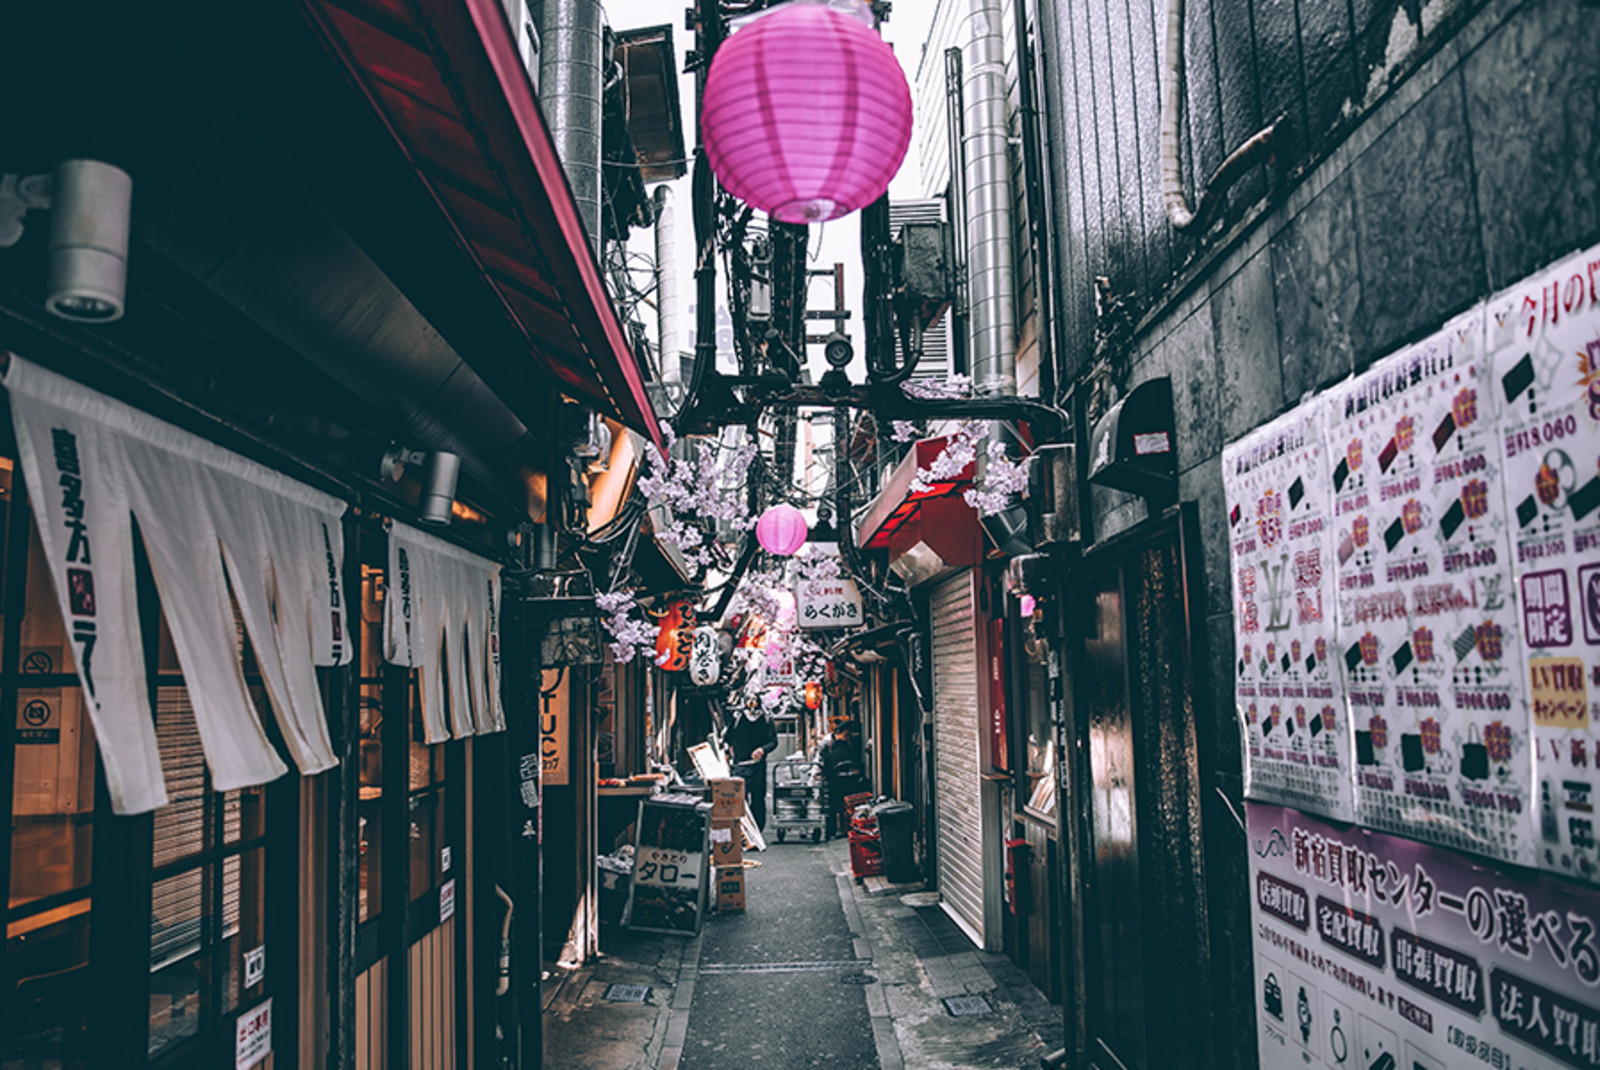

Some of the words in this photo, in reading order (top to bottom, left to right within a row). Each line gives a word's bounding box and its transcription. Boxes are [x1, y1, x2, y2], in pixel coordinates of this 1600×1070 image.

[804, 602, 858, 620] らくがき
[638, 861, 697, 883] タロー
[1292, 828, 1600, 987] 新宿買取センターの選べる
[1319, 905, 1380, 958] 宅配買取
[1396, 938, 1478, 1003] 出張買取
